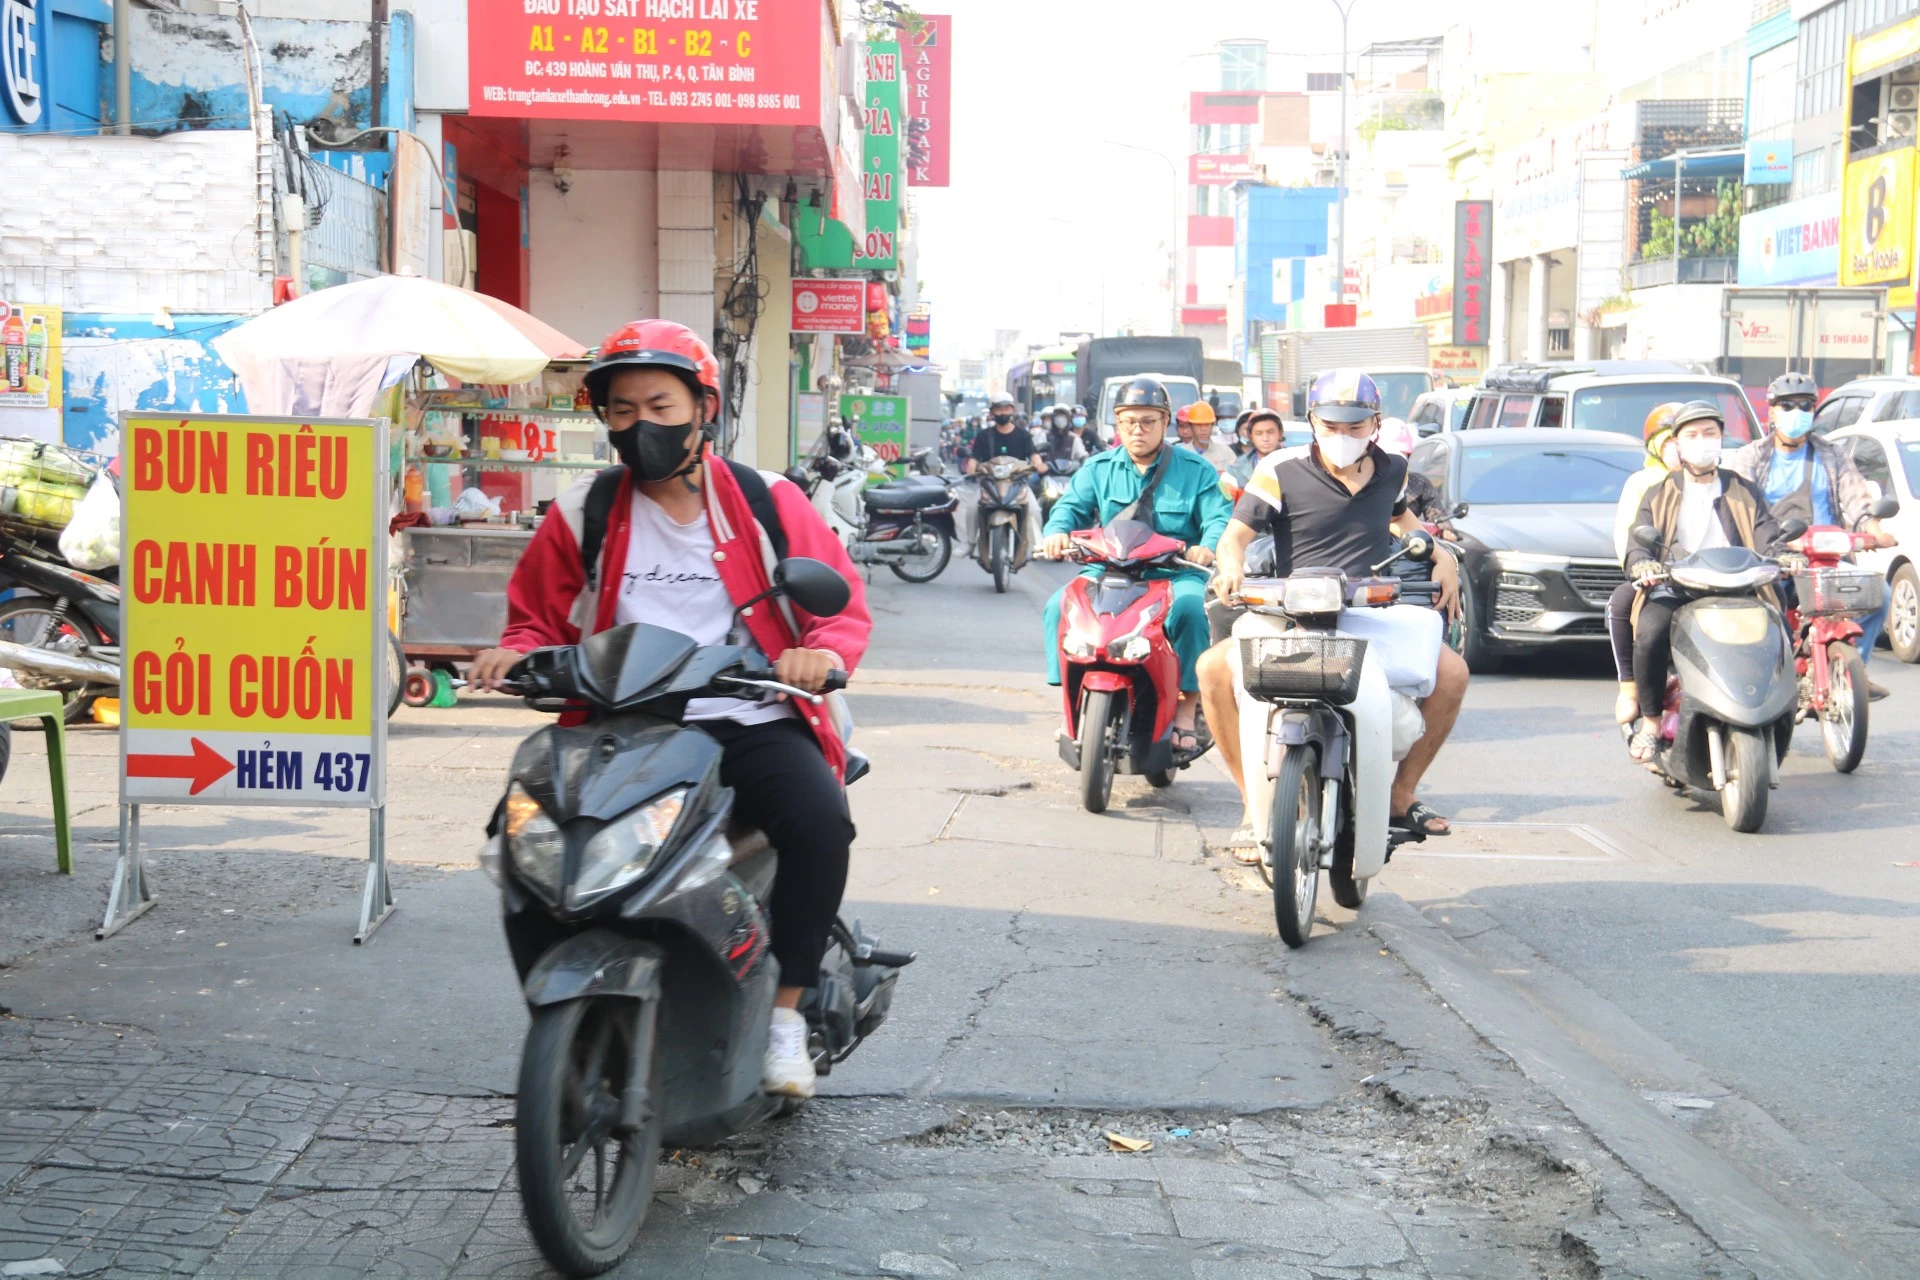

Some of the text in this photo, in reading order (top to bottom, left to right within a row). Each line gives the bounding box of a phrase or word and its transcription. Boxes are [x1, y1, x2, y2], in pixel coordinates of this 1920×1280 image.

[646, 0, 694, 22] HẠCH
[735, 0, 759, 21] XE
[529, 25, 555, 52] A1
[581, 27, 609, 54] A2
[633, 28, 658, 55] B1
[685, 30, 712, 57] B2
[736, 31, 751, 58] C
[525, 59, 755, 83] ĐC: 439 HOÀNG VĂN THỤ, P. 4, Q. TÂN BÌNH
[866, 46, 896, 81] ÁNH
[483, 86, 507, 102] WEB:
[670, 92, 689, 107] 093
[691, 92, 713, 107] 2745
[757, 94, 781, 109] 8985
[783, 95, 801, 109] 001
[915, 51, 932, 182] AGRIBANK
[1775, 215, 1840, 257] VIETBANK
[820, 303, 859, 313] money
[821, 295, 857, 303] viettel
[1819, 334, 1830, 344] XE
[134, 420, 348, 500] BÚN RIÊU
[133, 536, 366, 611] CANH BÚN
[133, 635, 353, 720] GỎI CUỐN
[237, 740, 371, 793] HẺM 437
